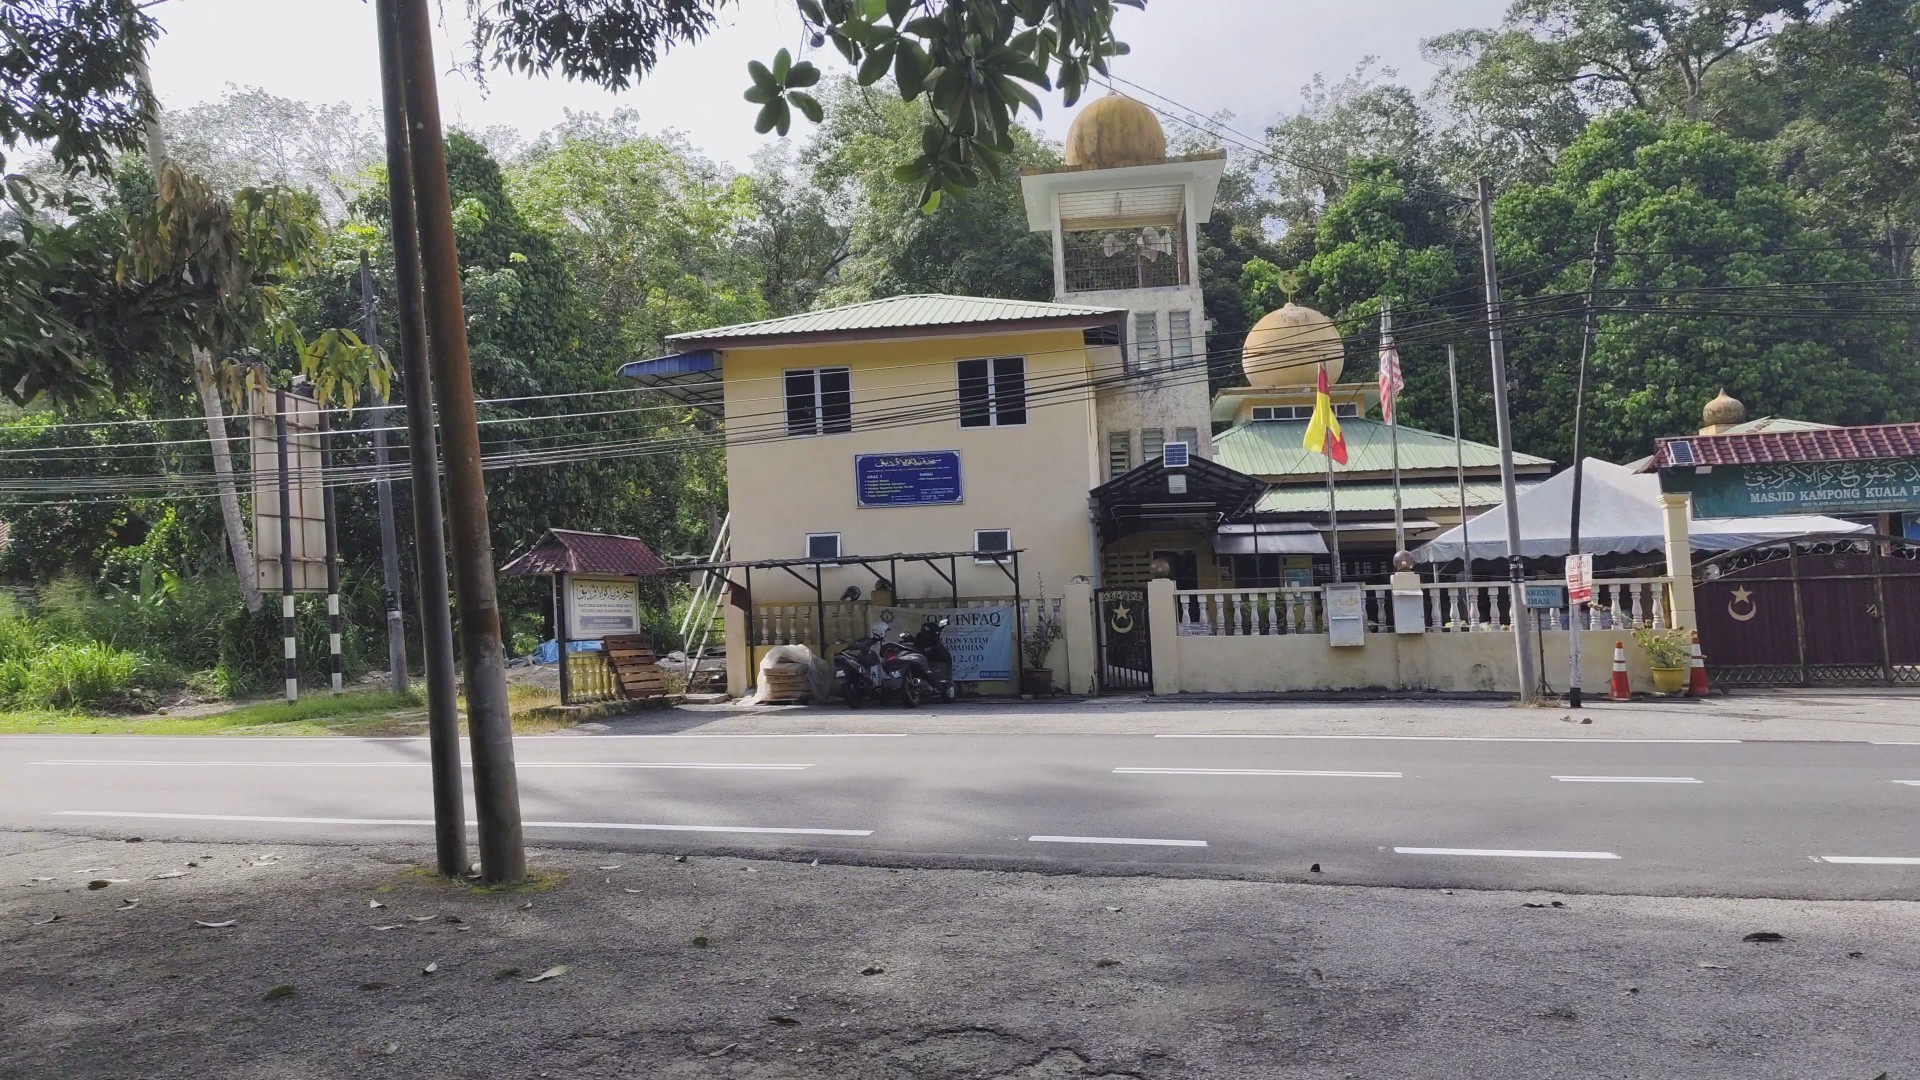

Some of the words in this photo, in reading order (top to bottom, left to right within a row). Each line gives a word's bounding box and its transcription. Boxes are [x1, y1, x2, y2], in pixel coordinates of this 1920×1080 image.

[1750, 492, 1795, 503] MASJID
[1800, 488, 1861, 501] KAMPONG
[1865, 486, 1908, 498] KUALA
[1526, 589, 1556, 597] ARKING
[922, 614, 951, 625] OM
[956, 612, 1001, 627] INFAQ
